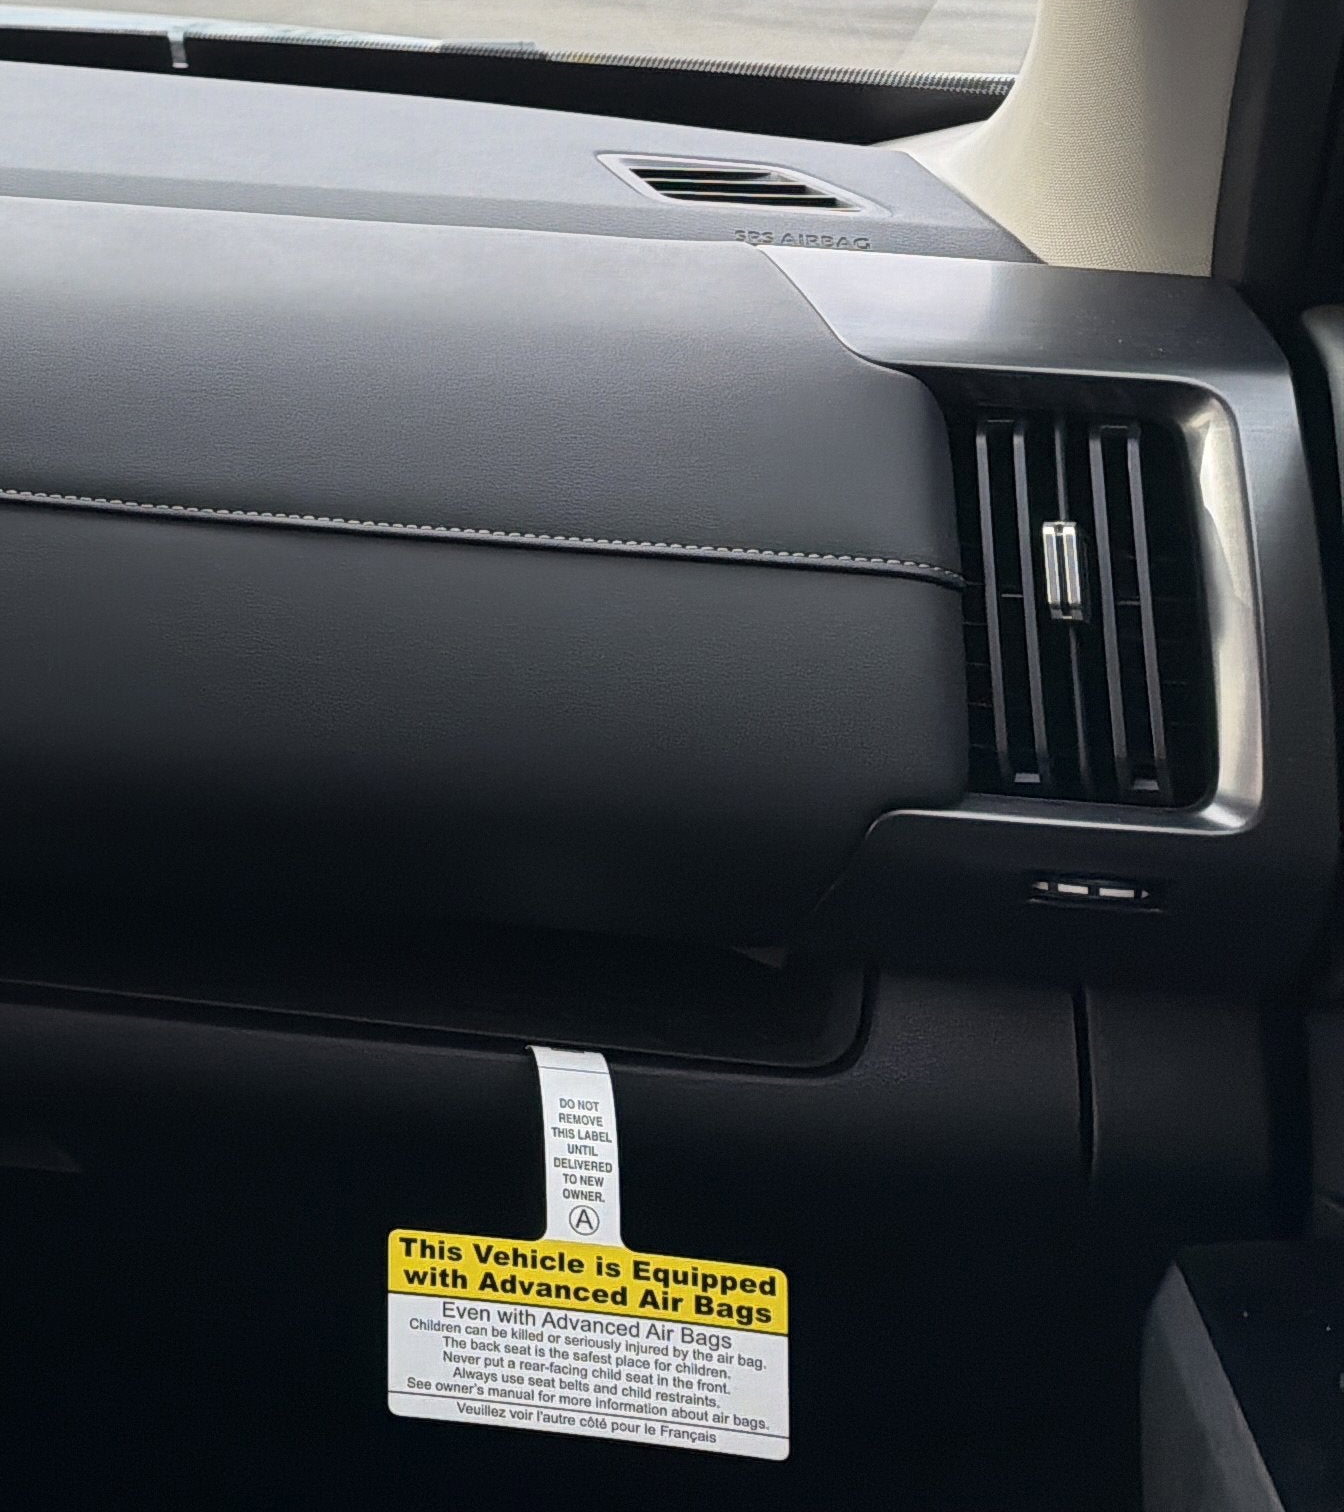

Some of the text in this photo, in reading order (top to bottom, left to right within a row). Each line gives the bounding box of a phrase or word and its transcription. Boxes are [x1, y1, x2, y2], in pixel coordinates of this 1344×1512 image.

[734, 229, 872, 251] SRS AIRBAG
[558, 1112, 603, 1127] REMOVE
[559, 1098, 599, 1112] DO NOT
[551, 1127, 612, 1143] THIS LABEL
[567, 1143, 598, 1157] UNTIL
[553, 1157, 613, 1173] DELIVERED
[562, 1173, 604, 1187] TO NEW
[562, 1188, 605, 1203] OWNER.
[399, 1237, 777, 1297] This Vehicle is Equipped
[403, 1266, 772, 1326] with Advanced Air Bags
[442, 1301, 733, 1352] Even with Advanced Air Bags
[409, 1317, 767, 1371] Children can be killed or seriously injured by the air bag.
[442, 1335, 731, 1380] The back seat is the safest place for children.
[442, 1350, 731, 1395] Never put a rear-facing child seat in the front.
[407, 1376, 770, 1432] See owner's manual for more information about air bags.
[457, 1401, 717, 1444] Veuillez voir l'autre côté pour le Français
